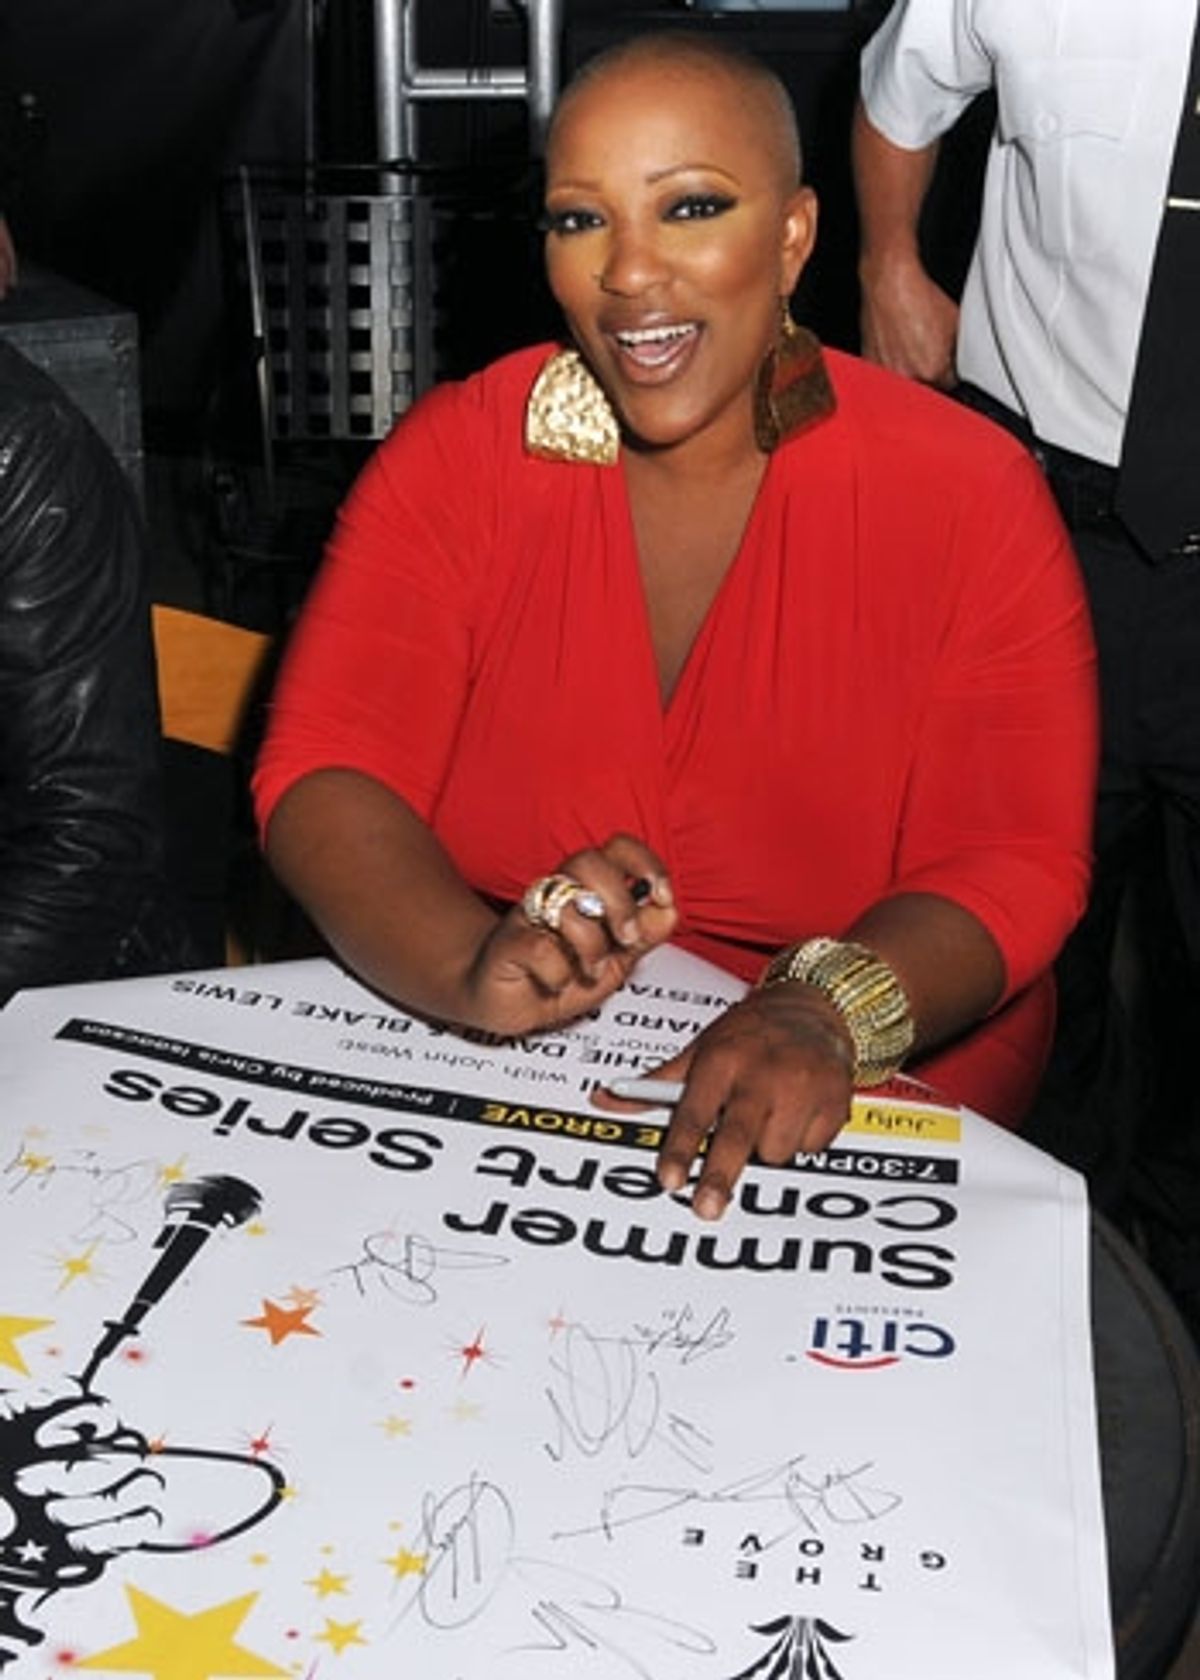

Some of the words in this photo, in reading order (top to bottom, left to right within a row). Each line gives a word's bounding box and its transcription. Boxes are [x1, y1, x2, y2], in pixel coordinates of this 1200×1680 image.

[171, 979, 284, 1010] LEWIS
[292, 1001, 412, 1034] BLAKE
[199, 1051, 265, 1075] Chris
[272, 1066, 303, 1084] by
[425, 1053, 495, 1074] John
[502, 1063, 568, 1085] with
[308, 1076, 434, 1105] Produced
[103, 1069, 444, 1171] Series
[480, 1104, 623, 1140] GROVE
[865, 1109, 936, 1134] July
[795, 1151, 939, 1181] 7:30PM
[443, 1201, 958, 1290] Summer
[809, 1318, 956, 1360] citi
[684, 1529, 946, 1571] GROVE
[735, 1562, 882, 1592] THE
